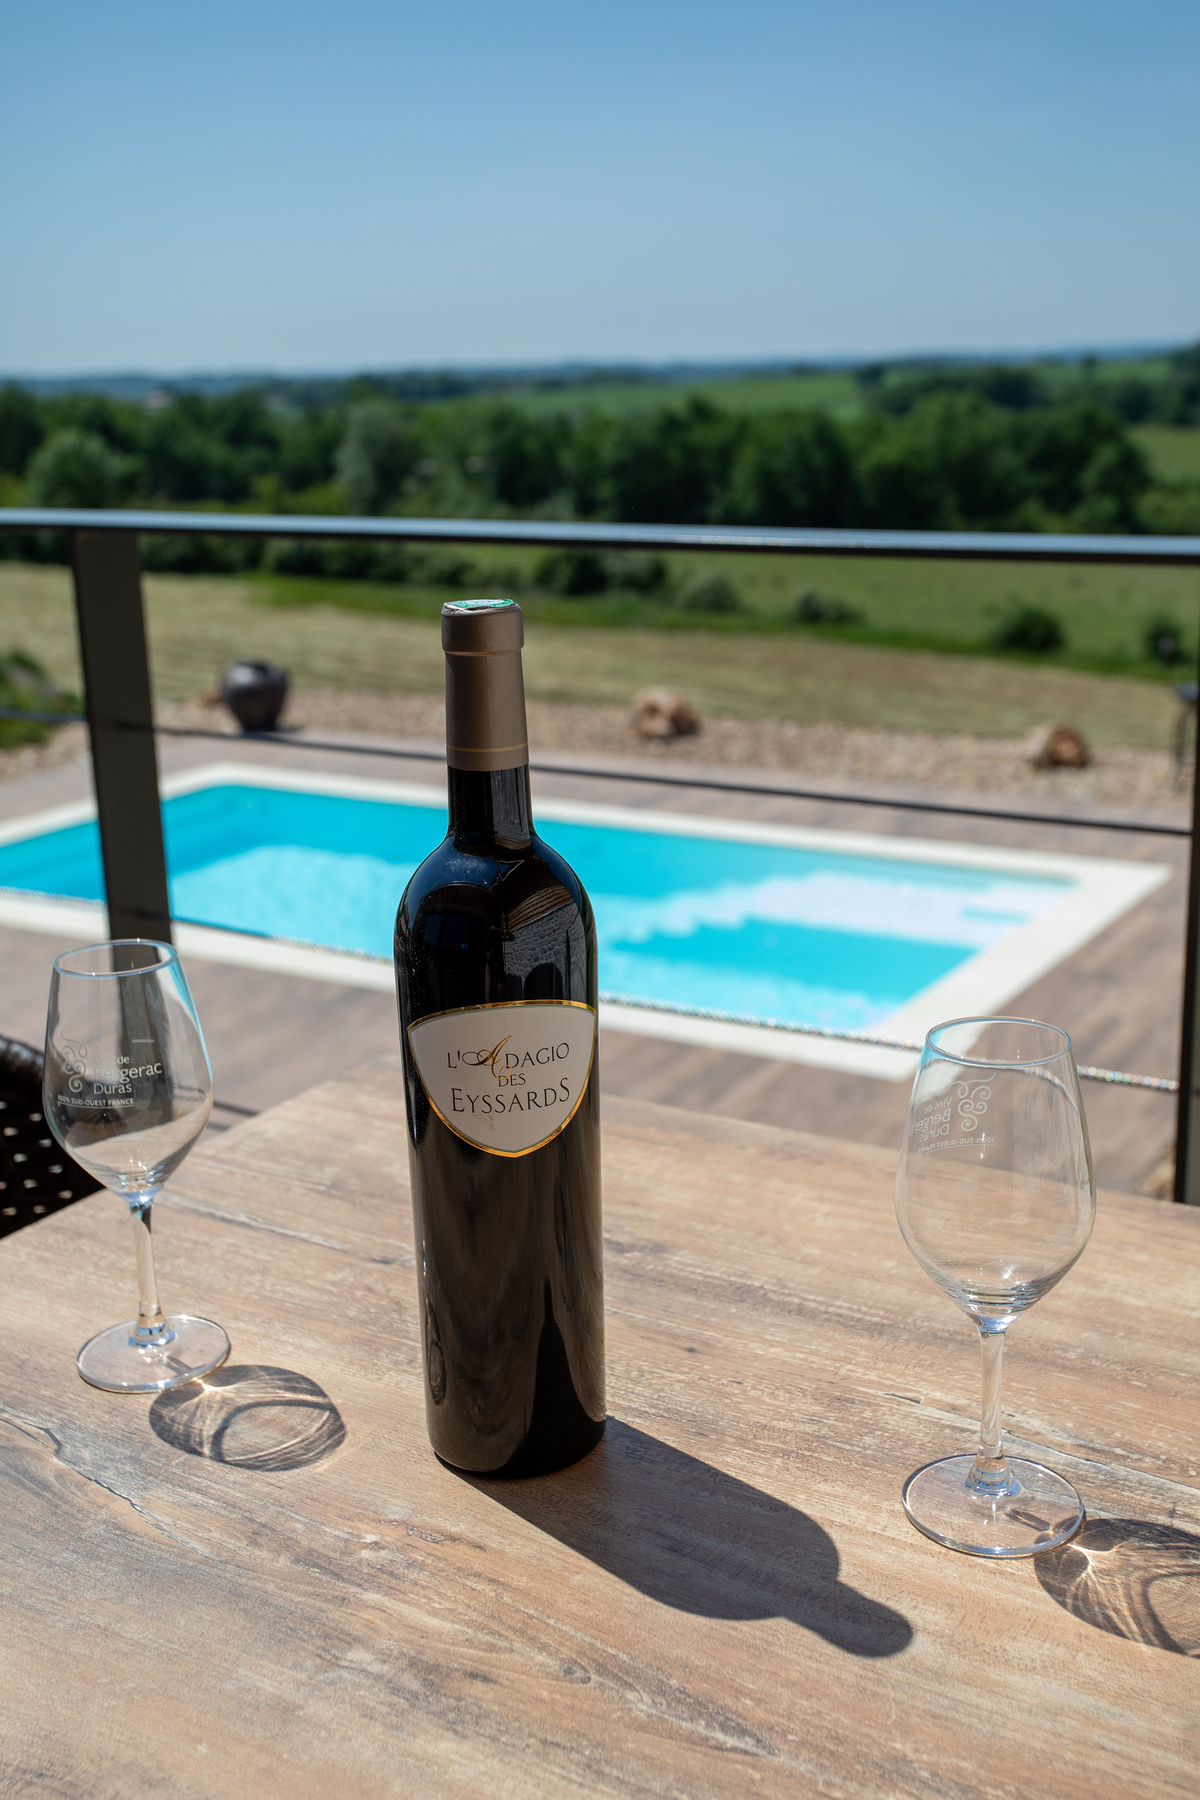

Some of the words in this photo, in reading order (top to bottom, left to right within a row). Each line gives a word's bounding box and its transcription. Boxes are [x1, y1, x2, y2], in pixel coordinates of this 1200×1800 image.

[117, 1055, 130, 1064] de
[447, 1035, 570, 1080] L'ADAGIO
[93, 1062, 163, 1084] Bergerac
[498, 1073, 526, 1087] DES
[93, 1083, 133, 1095] Duras
[451, 1077, 570, 1114] EYSSARDS
[71, 1098, 107, 1107] SUD-OUEST
[108, 1098, 134, 1107] FRANCE
